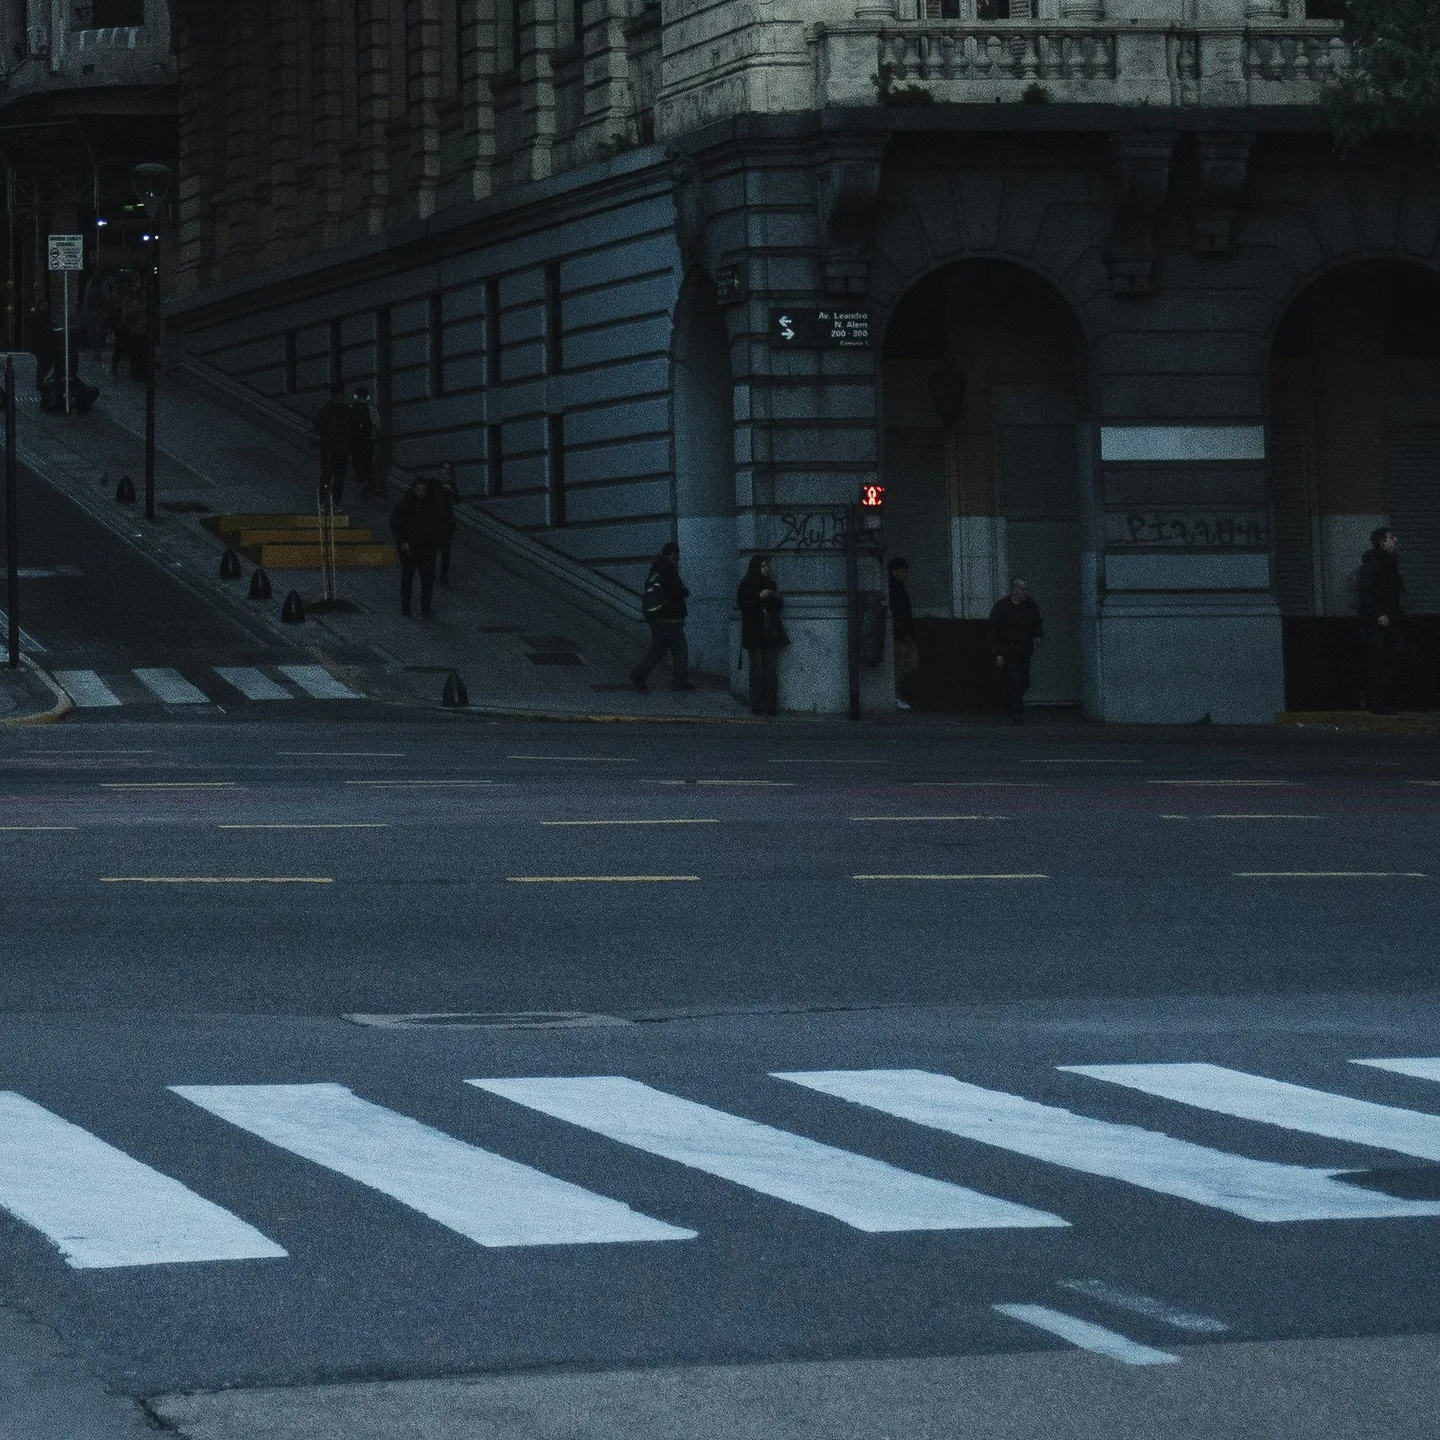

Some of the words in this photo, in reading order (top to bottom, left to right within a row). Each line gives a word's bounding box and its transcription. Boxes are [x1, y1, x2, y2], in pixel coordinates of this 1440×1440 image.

[817, 311, 831, 320] Av.
[833, 311, 868, 320] Leandro
[834, 320, 843, 329] N.
[846, 320, 868, 329] Alem
[830, 329, 846, 338] 200
[852, 329, 869, 338] 300
